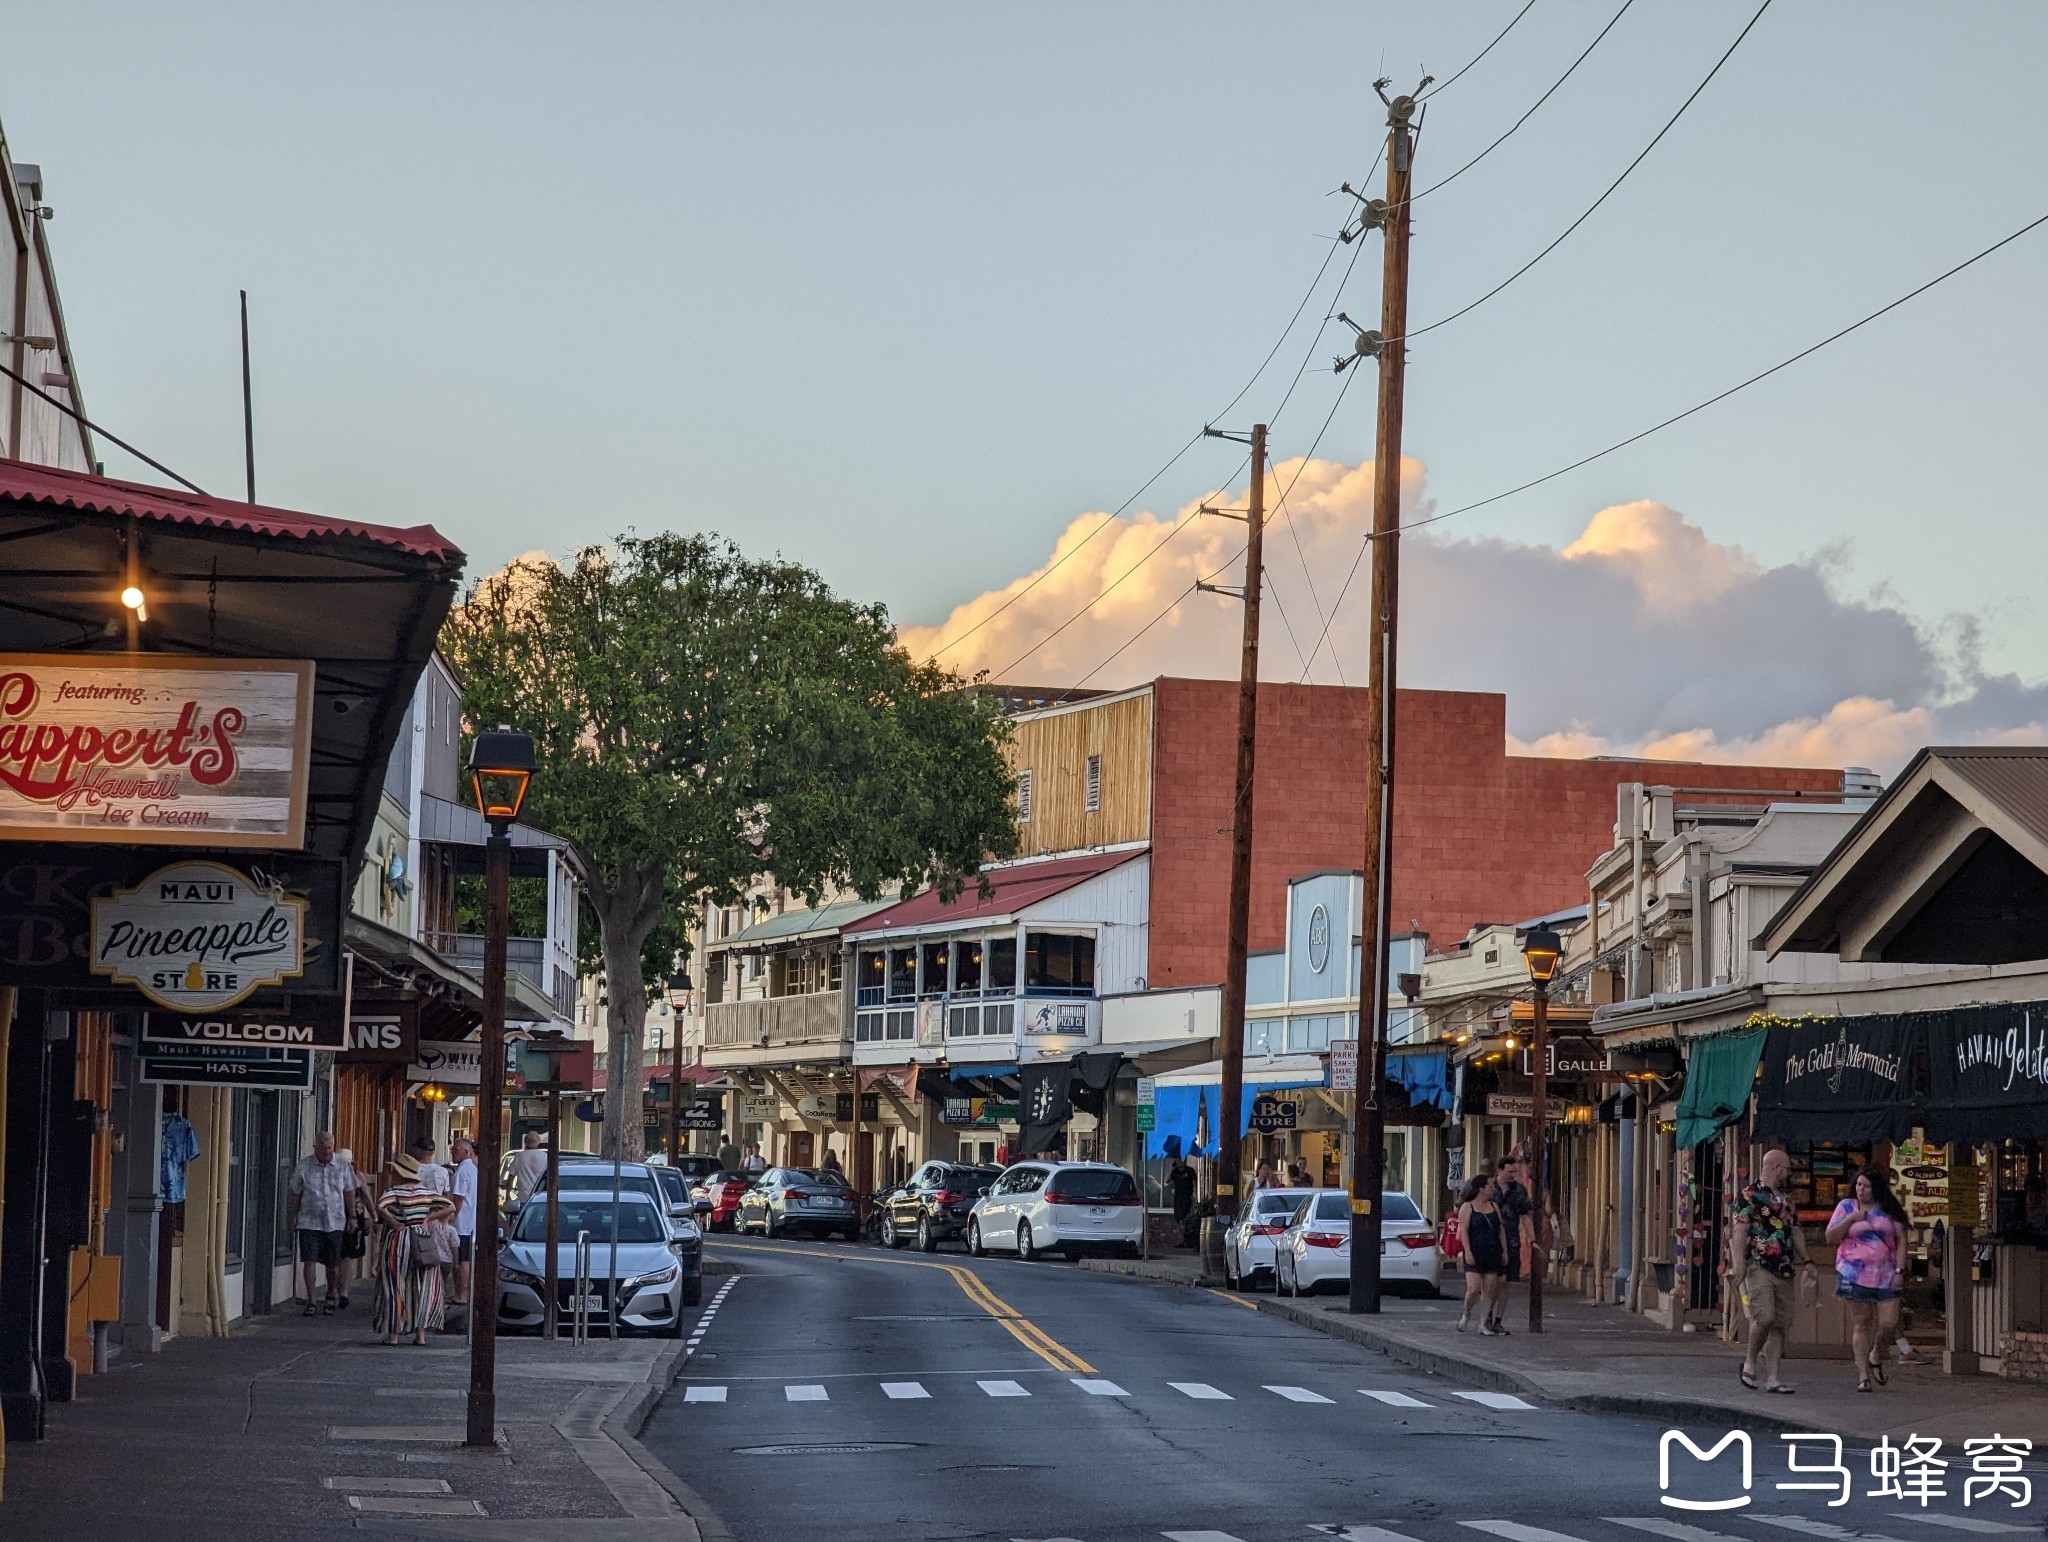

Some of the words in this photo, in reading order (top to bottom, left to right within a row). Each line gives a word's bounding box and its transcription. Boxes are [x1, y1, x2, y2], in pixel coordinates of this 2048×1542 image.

[57, 763, 181, 812] Hawaii
[99, 803, 132, 823] Ice
[138, 804, 210, 825] Cream
[160, 884, 234, 900] MAUI
[101, 906, 289, 963] Pineapple
[1058, 1005, 1085, 1018] LAHAINA
[1058, 1017, 1074, 1026] PIZZA
[181, 1021, 314, 1042] VOLCOM
[1957, 1033, 2003, 1073] HAWAII
[206, 1064, 248, 1074] HATS
[1784, 1055, 1805, 1085] The
[1807, 1043, 1835, 1073] Gold
[1845, 1043, 1901, 1082] Mermaid
[1491, 1098, 1531, 1110] Elephan
[1252, 1117, 1294, 1126] TORE
